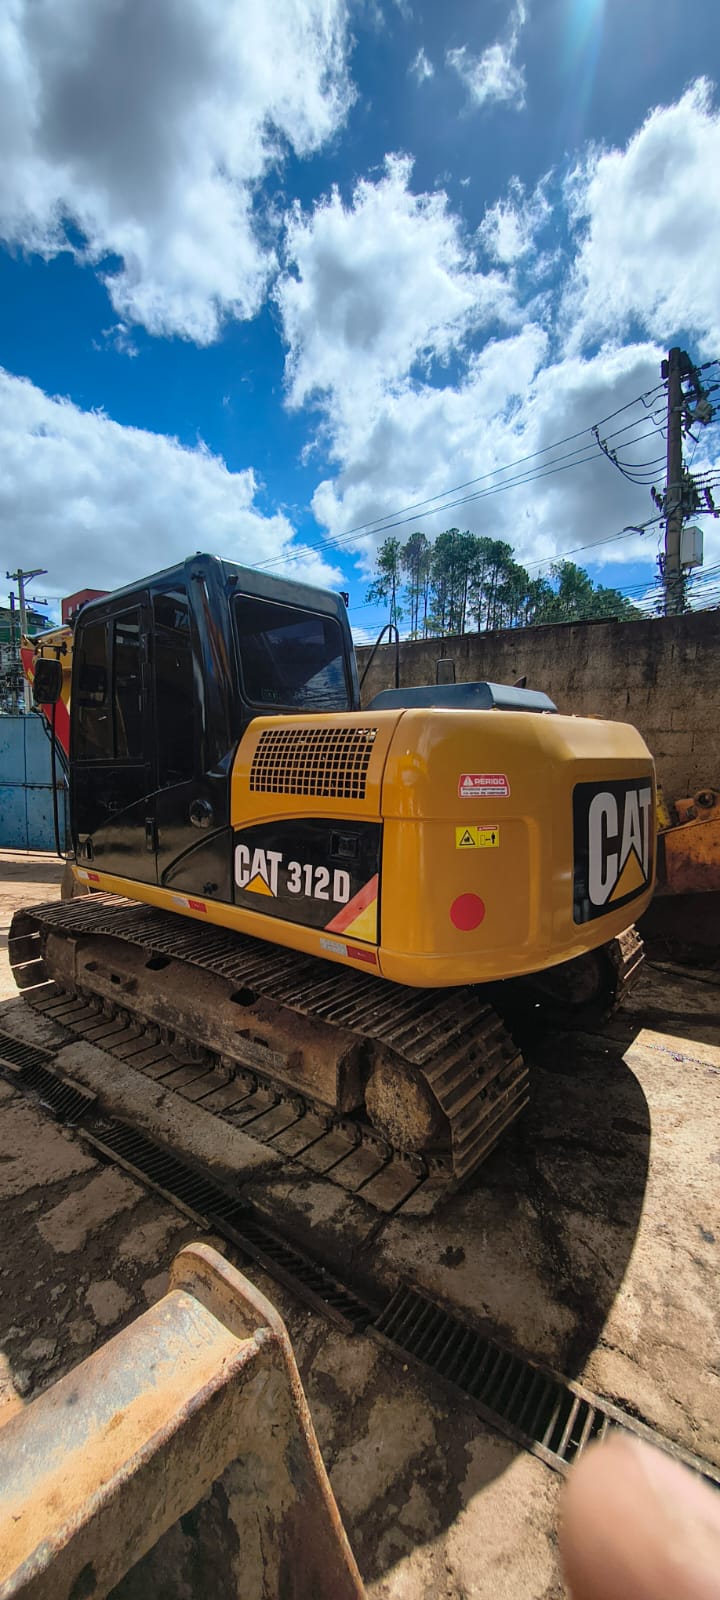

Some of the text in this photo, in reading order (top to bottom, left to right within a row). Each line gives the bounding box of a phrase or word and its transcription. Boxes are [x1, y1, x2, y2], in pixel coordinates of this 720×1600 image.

[234, 844, 351, 904] CAT 312D
[588, 787, 652, 906] CAT
